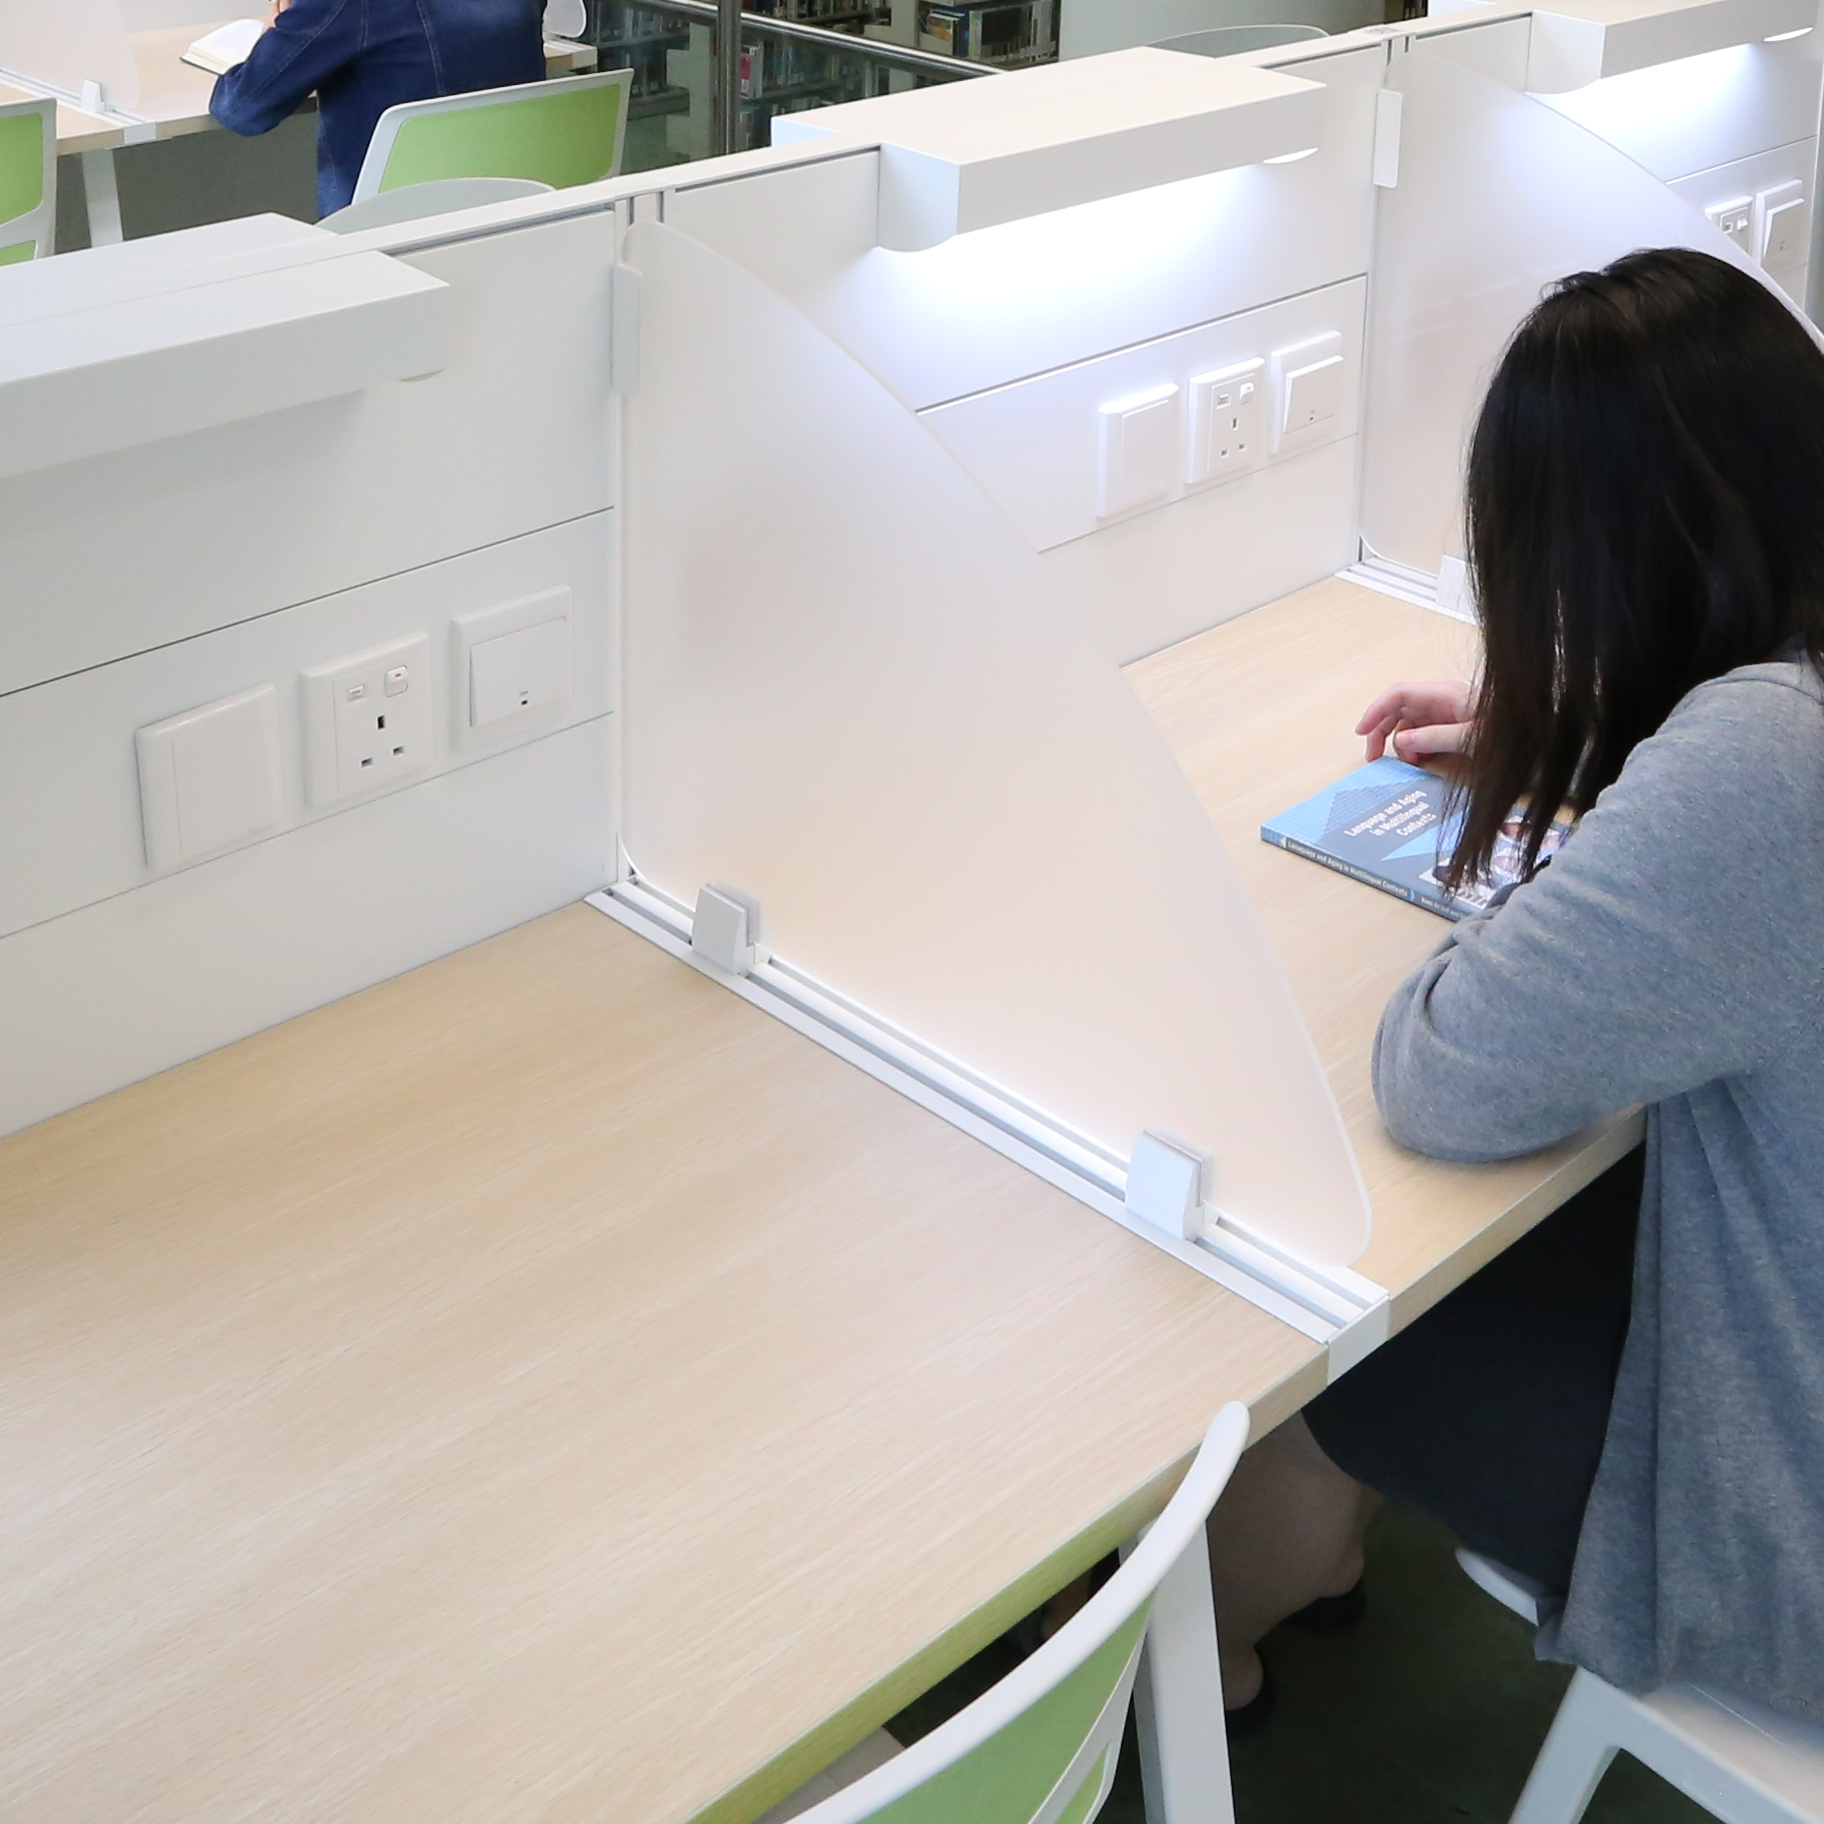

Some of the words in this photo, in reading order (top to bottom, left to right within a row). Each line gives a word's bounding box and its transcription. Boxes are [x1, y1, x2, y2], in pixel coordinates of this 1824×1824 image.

[1343, 812, 1387, 836] Language
[1384, 802, 1403, 815] and
[1398, 790, 1428, 806] Aging
[1396, 813, 1437, 836] Contexts
[1369, 828, 1386, 836] in
